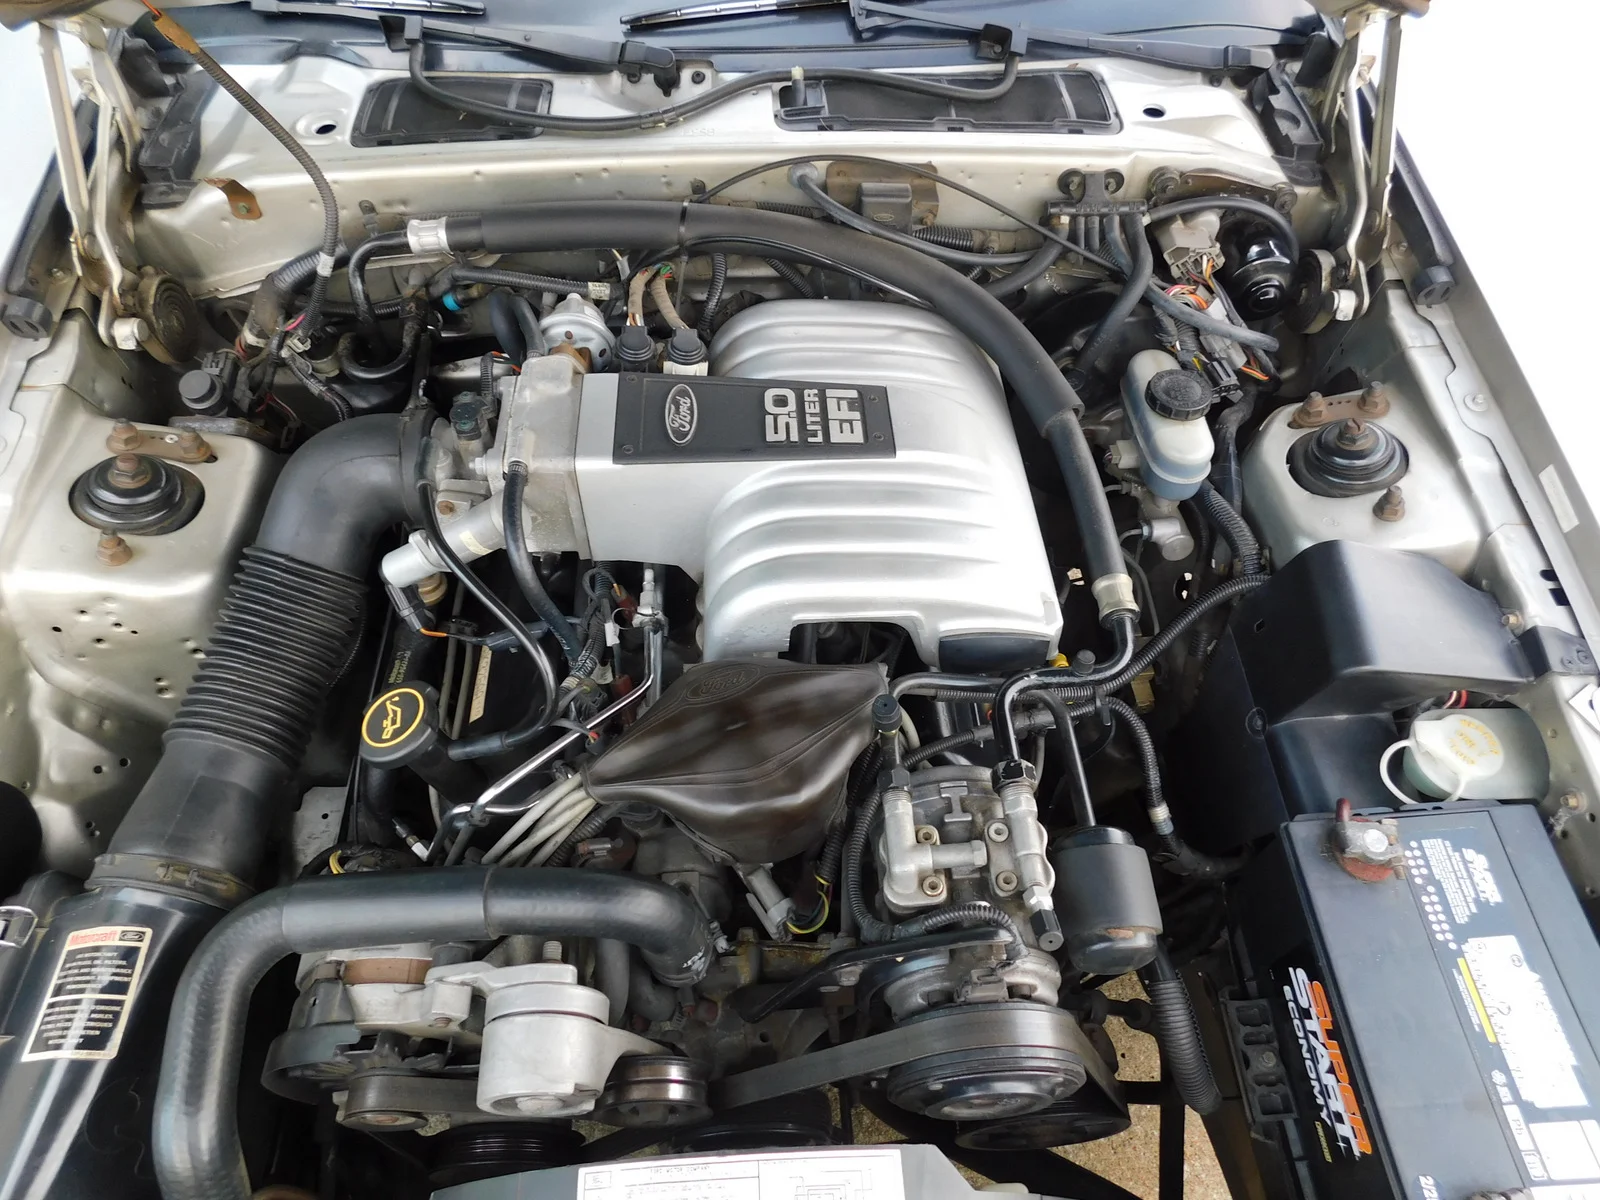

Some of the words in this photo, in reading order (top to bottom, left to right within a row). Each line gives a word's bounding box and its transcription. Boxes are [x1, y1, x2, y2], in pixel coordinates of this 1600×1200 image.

[764, 388, 799, 443] 5.0
[803, 388, 824, 443] LITER
[825, 388, 865, 444] EFI
[69, 930, 118, 947] Motorcraft
[1283, 985, 1333, 1128] ECONOMY
[1288, 967, 1361, 1161] START
[1308, 980, 1373, 1155] SUPER
[1418, 1174, 1440, 1200] 2/2
